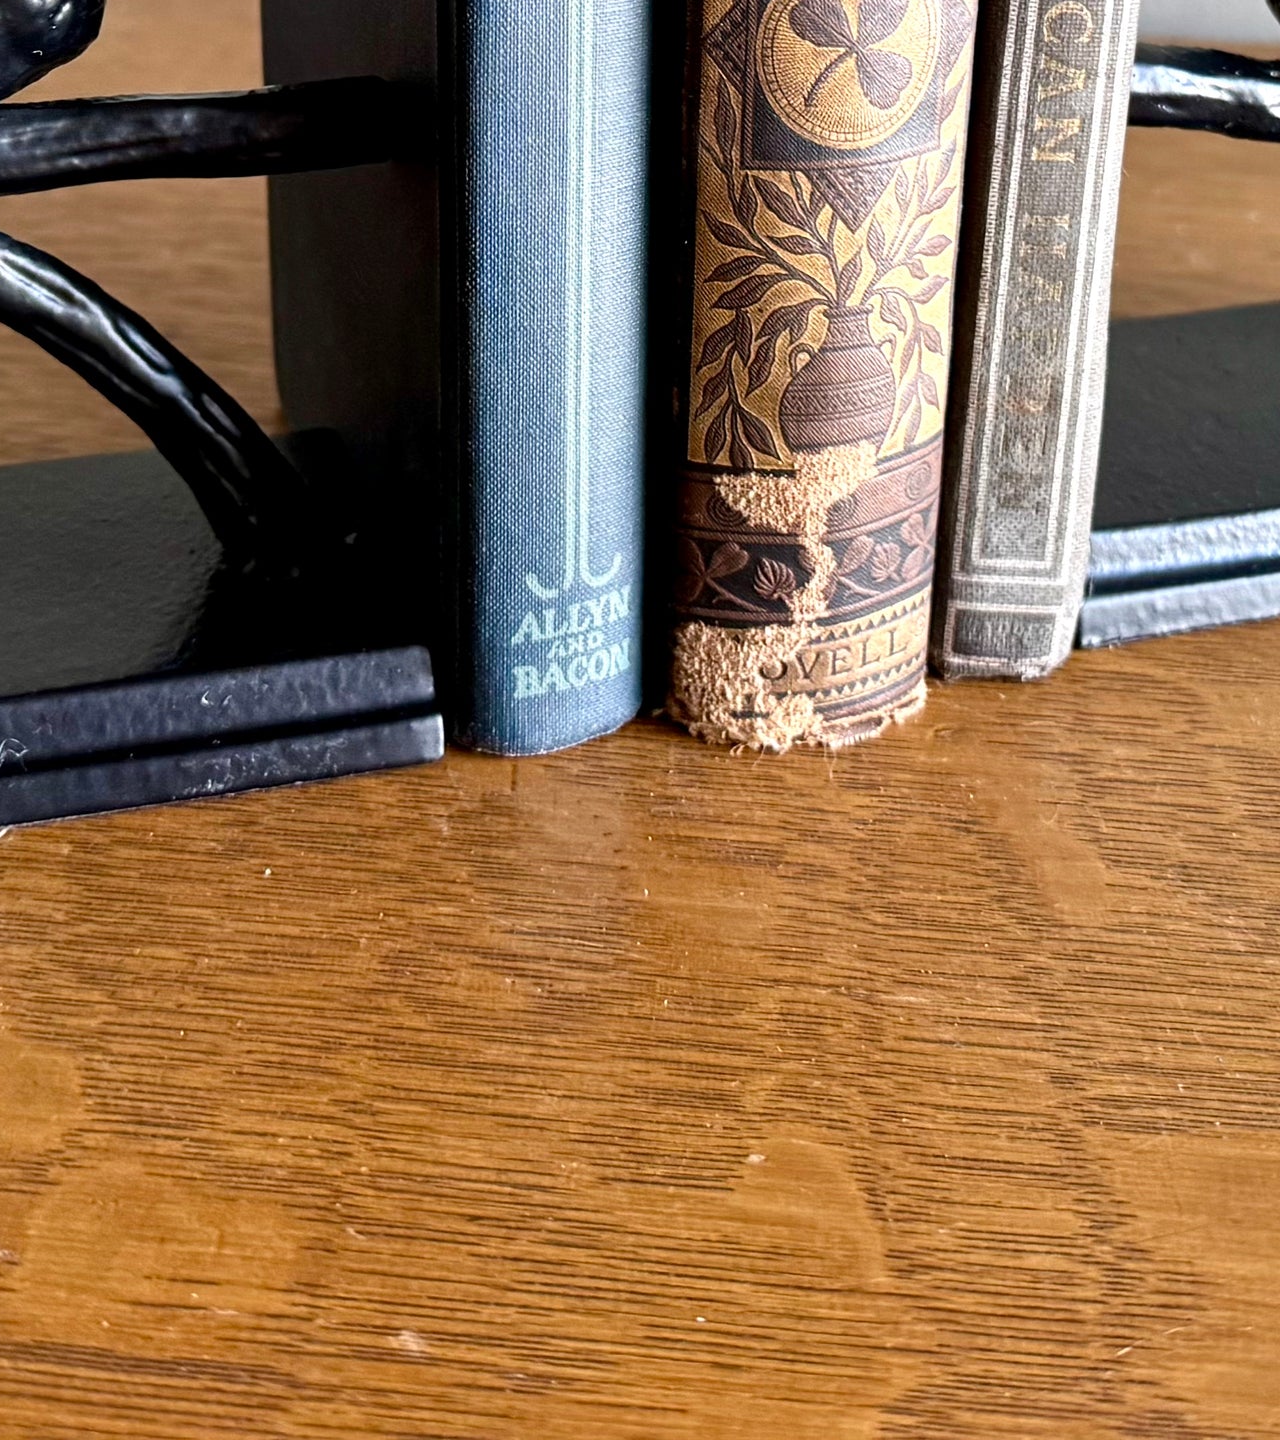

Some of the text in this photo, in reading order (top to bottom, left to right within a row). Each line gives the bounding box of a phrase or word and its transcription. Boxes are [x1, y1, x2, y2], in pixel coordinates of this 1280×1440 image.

[1031, 0, 1094, 164] CAN
[511, 584, 632, 646] ALLYN
[547, 630, 605, 660] AND
[512, 638, 632, 699] BACON
